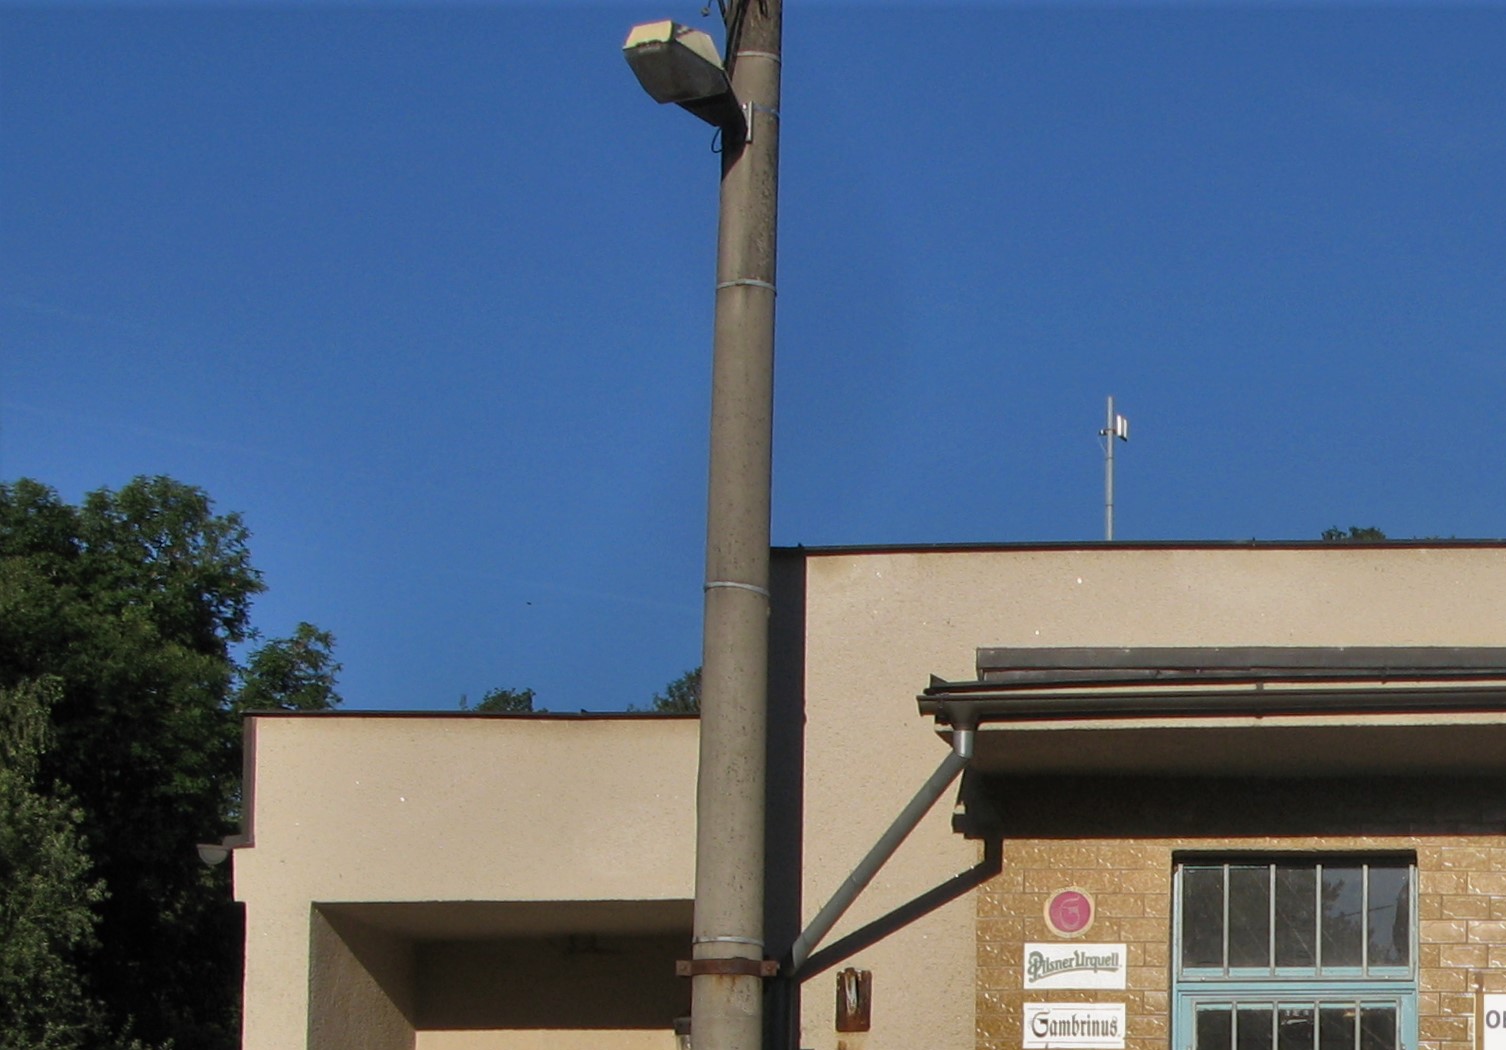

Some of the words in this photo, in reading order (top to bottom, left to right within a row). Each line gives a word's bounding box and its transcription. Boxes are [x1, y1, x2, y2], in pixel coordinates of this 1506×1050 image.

[1027, 951, 1075, 983] Pilsner
[1074, 950, 1119, 973] Urquell
[1031, 1009, 1118, 1038] Gambrinus
